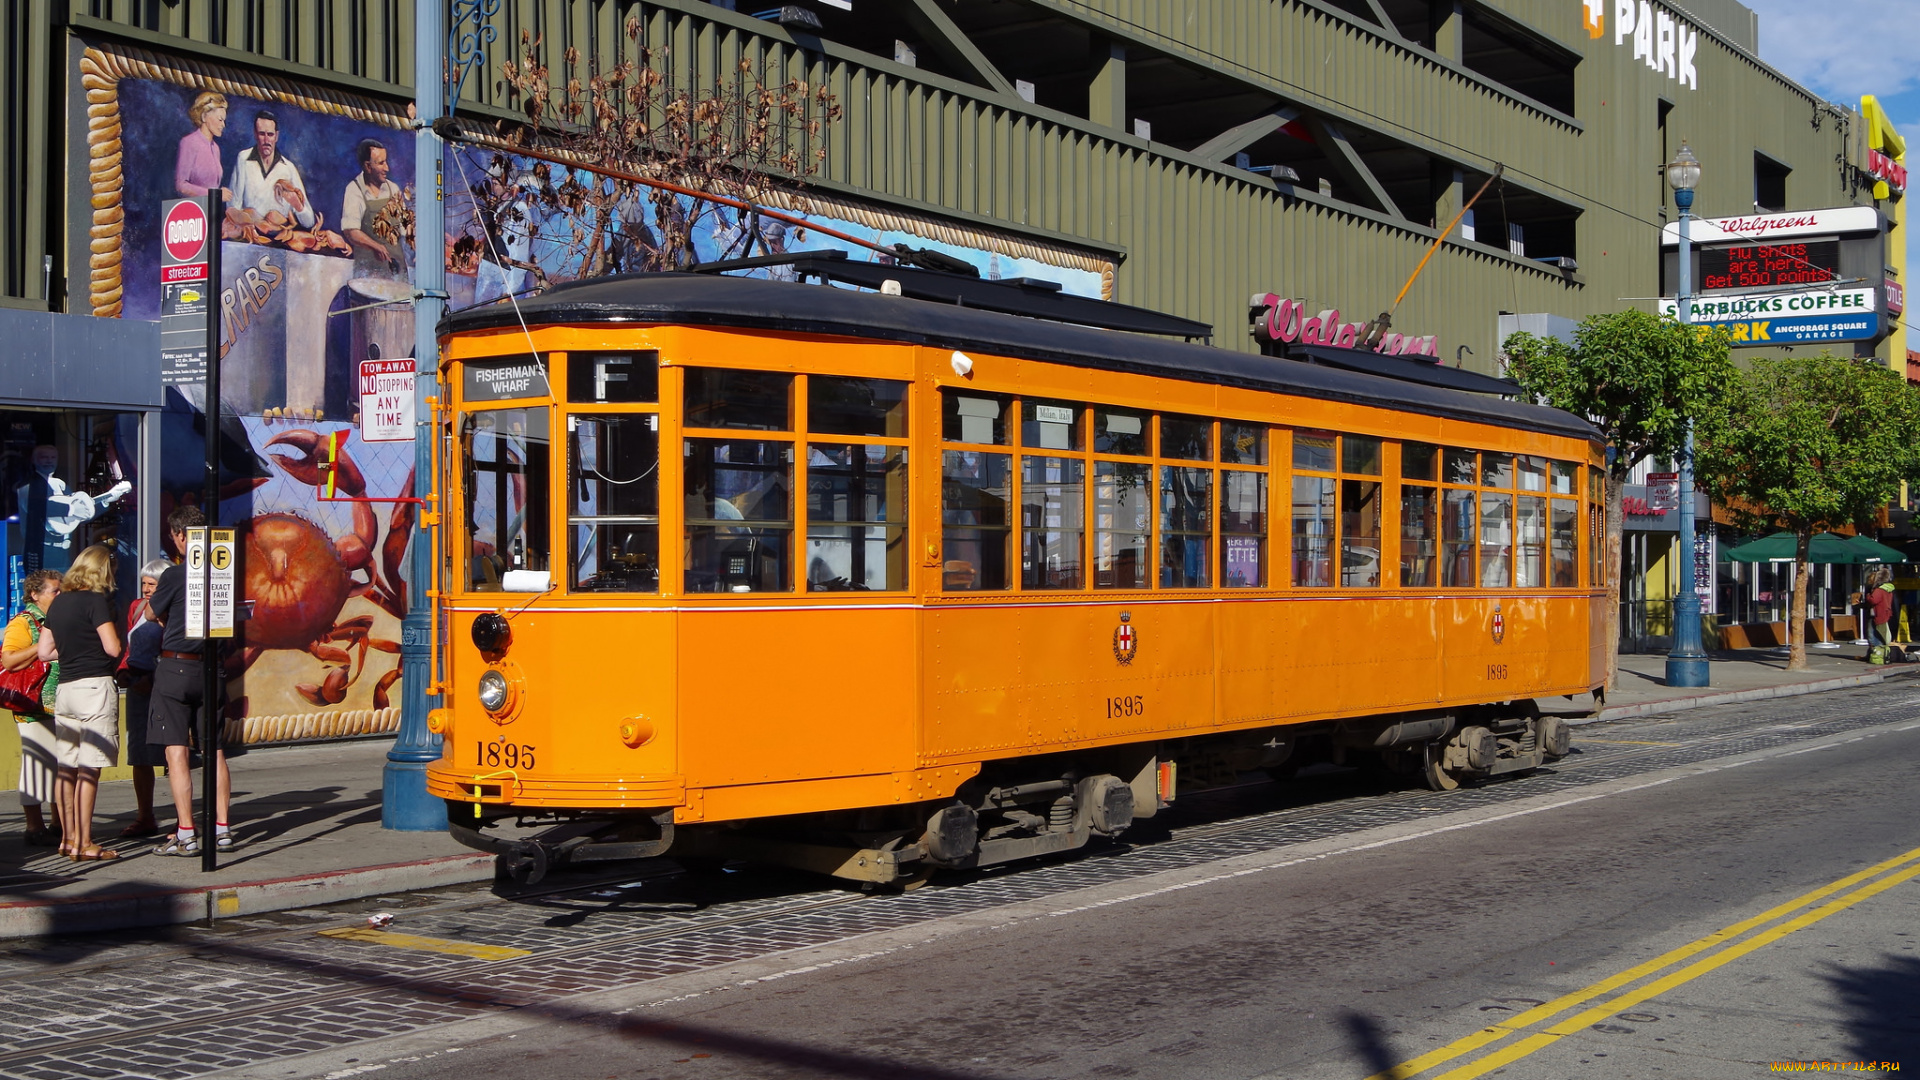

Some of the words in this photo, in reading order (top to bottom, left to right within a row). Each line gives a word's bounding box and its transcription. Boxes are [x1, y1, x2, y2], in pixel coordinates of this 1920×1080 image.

[1615, 0, 1696, 90] PARK
[1720, 215, 1818, 235] Walgreens
[1729, 247, 1752, 260] Flu
[1758, 243, 1807, 258] Shots
[168, 266, 203, 279] streetcar
[1729, 261, 1758, 273] are
[1765, 256, 1809, 271] here!
[1706, 275, 1733, 288] Get
[1740, 272, 1770, 286] 500
[1777, 268, 1832, 285] points!
[166, 285, 173, 299] F
[1885, 286, 1902, 306] OTLE
[220, 255, 283, 360] RABS
[1667, 298, 1783, 316] SARBUCKS
[1788, 294, 1864, 311] COFFEE
[1252, 293, 1445, 365] Walgeens
[1775, 323, 1829, 333] ANCHORAGE
[1831, 322, 1867, 331] SQUARE
[1796, 331, 1844, 339] GARAGE
[364, 361, 413, 373] TOW-AWAY
[476, 364, 546, 382] FISHERMAN'S
[362, 375, 376, 394] NO
[378, 377, 413, 392] STOPPING
[594, 356, 633, 399] F
[492, 379, 531, 394] WHARF
[378, 396, 400, 410] ANY
[376, 412, 402, 426] TIME
[193, 550, 201, 565] F
[217, 550, 226, 565] F
[1228, 548, 1258, 563] ETTE
[1487, 664, 1508, 680] 1895
[1107, 695, 1143, 718] 1895
[477, 741, 536, 770] 1895
